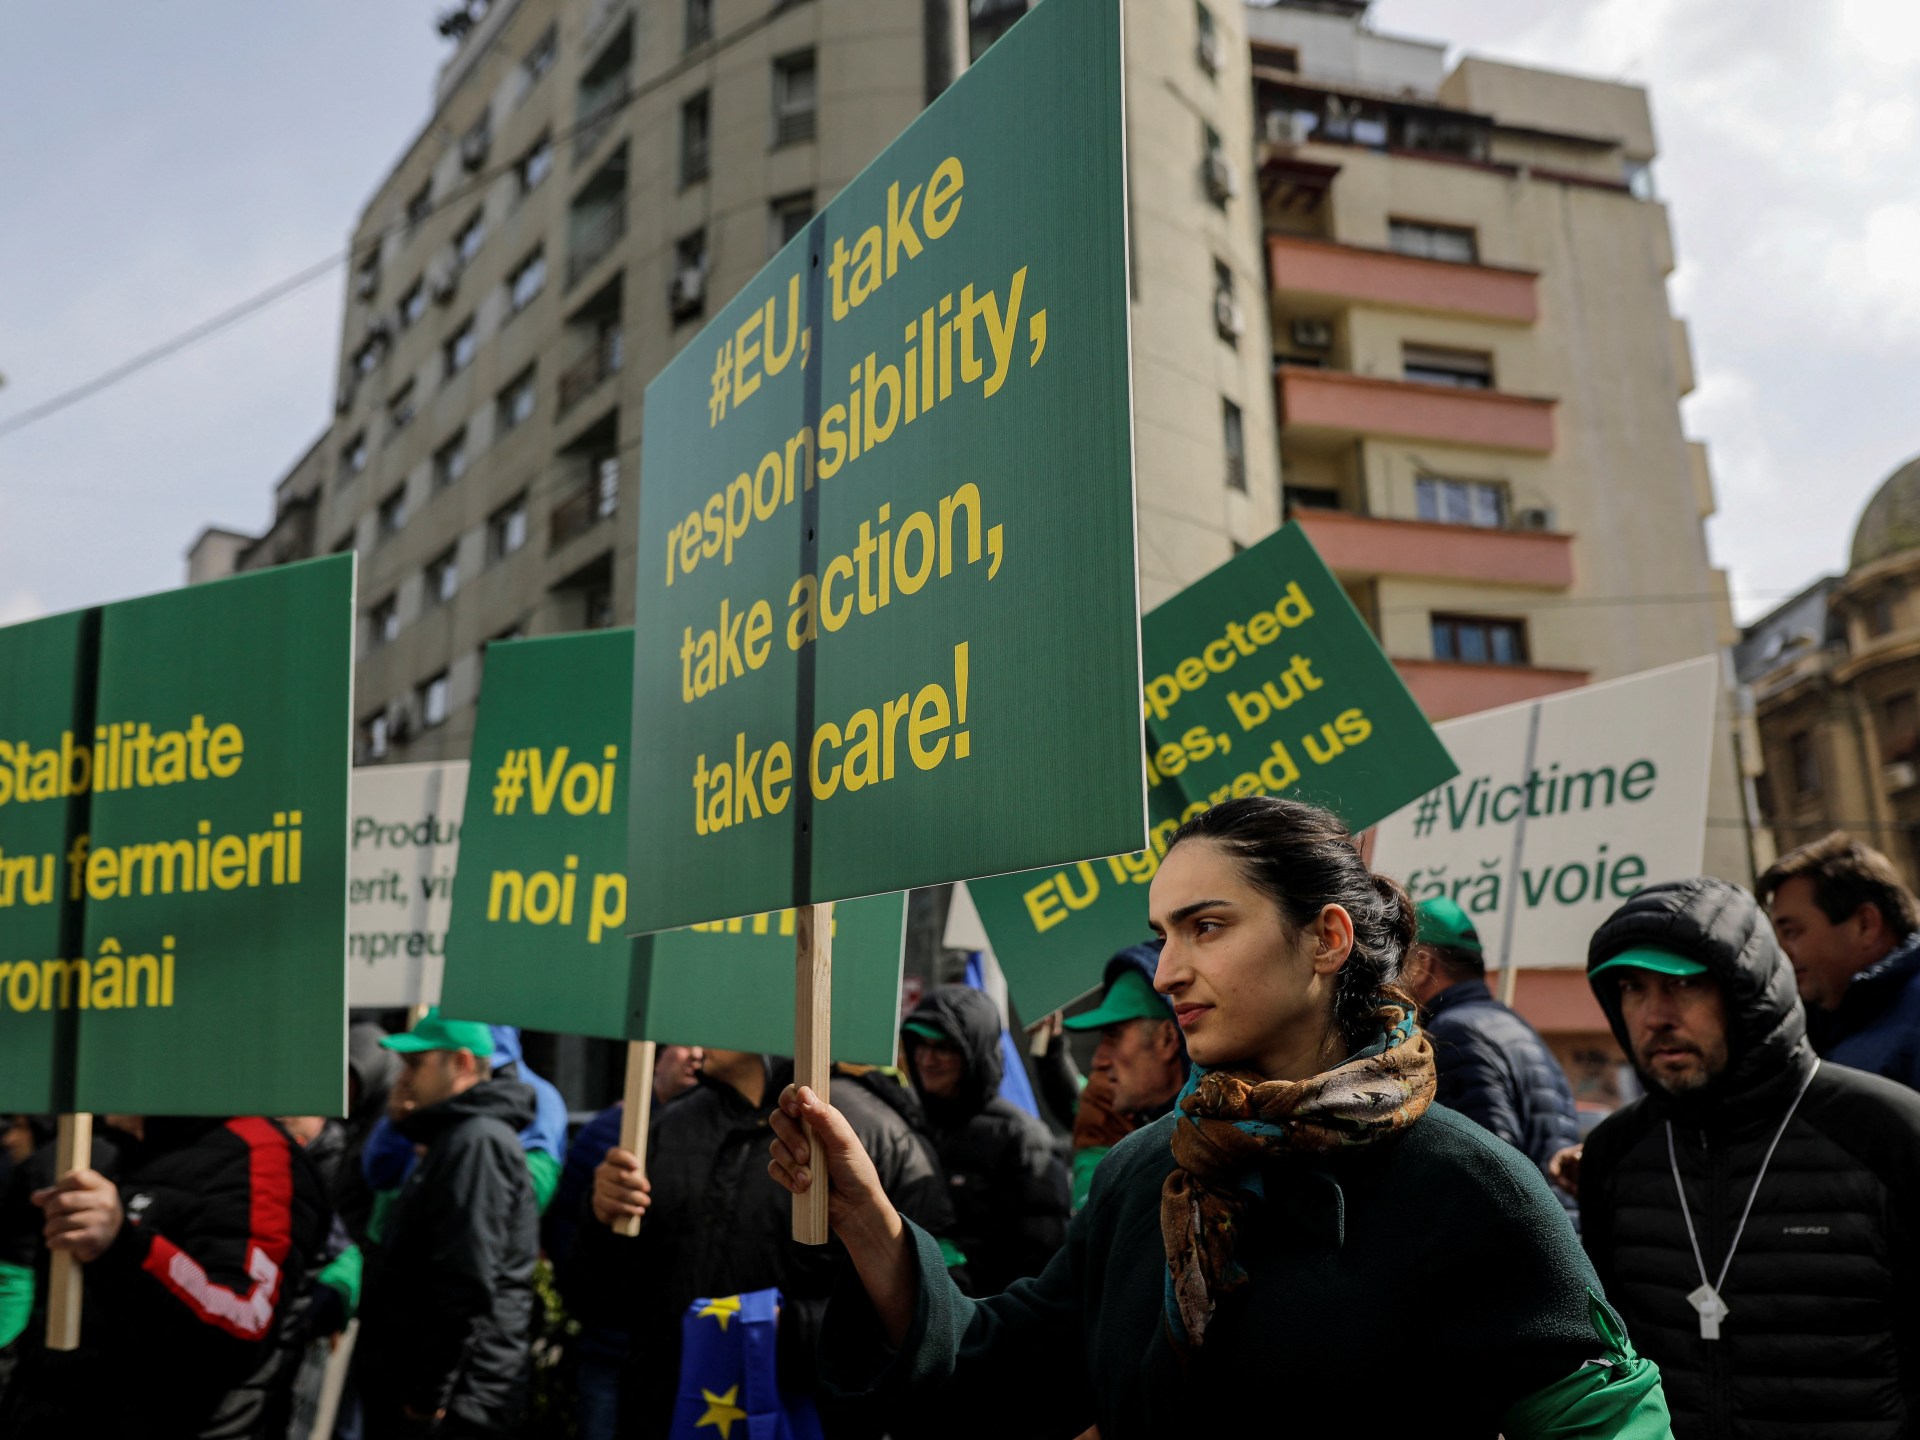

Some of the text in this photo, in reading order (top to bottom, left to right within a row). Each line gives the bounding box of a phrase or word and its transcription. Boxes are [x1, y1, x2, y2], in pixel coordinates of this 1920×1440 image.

[708, 156, 965, 429] #EU, take
[665, 265, 1047, 588] responsibility,
[680, 482, 1004, 703] take action,
[1145, 580, 1315, 723] pected
[1226, 654, 1325, 732] but
[492, 744, 619, 816] #Voi
[693, 640, 970, 836] take care!
[353, 813, 461, 848] Produ
[1022, 861, 1101, 934] EU
[1302, 707, 1374, 766] us
[1412, 758, 1657, 838] #Victime
[0, 811, 303, 907] ru fermierii
[486, 854, 579, 926] noi
[1519, 844, 1646, 908] voie
